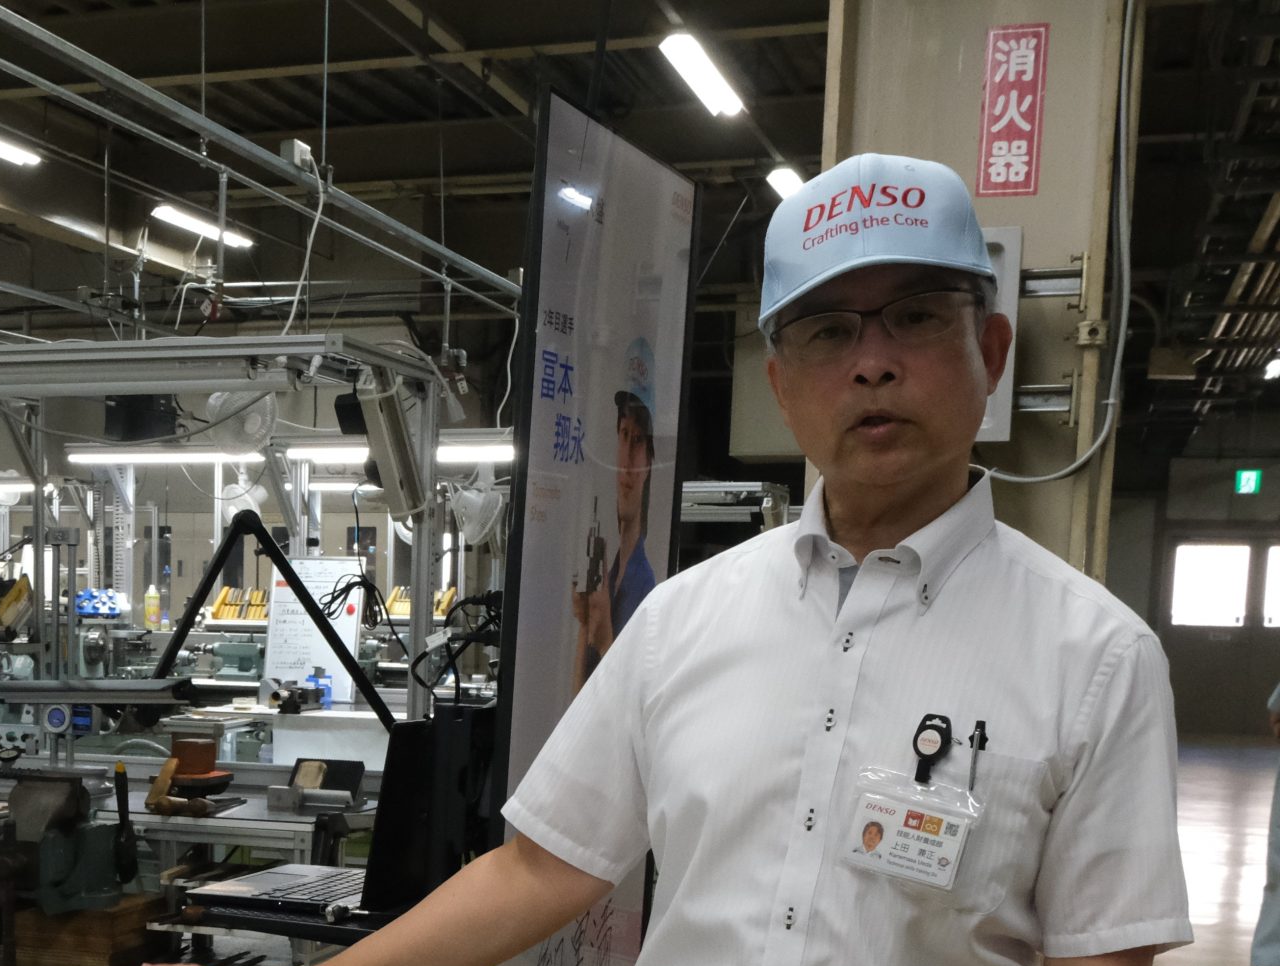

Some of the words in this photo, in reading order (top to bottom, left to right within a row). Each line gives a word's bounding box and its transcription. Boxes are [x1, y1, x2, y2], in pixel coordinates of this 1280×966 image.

[988, 38, 1038, 183] 消火器
[803, 184, 926, 233] DENSO
[802, 221, 859, 251] Crafting
[862, 215, 890, 229] the
[894, 213, 929, 228] Core
[865, 802, 897, 817] DENSO
